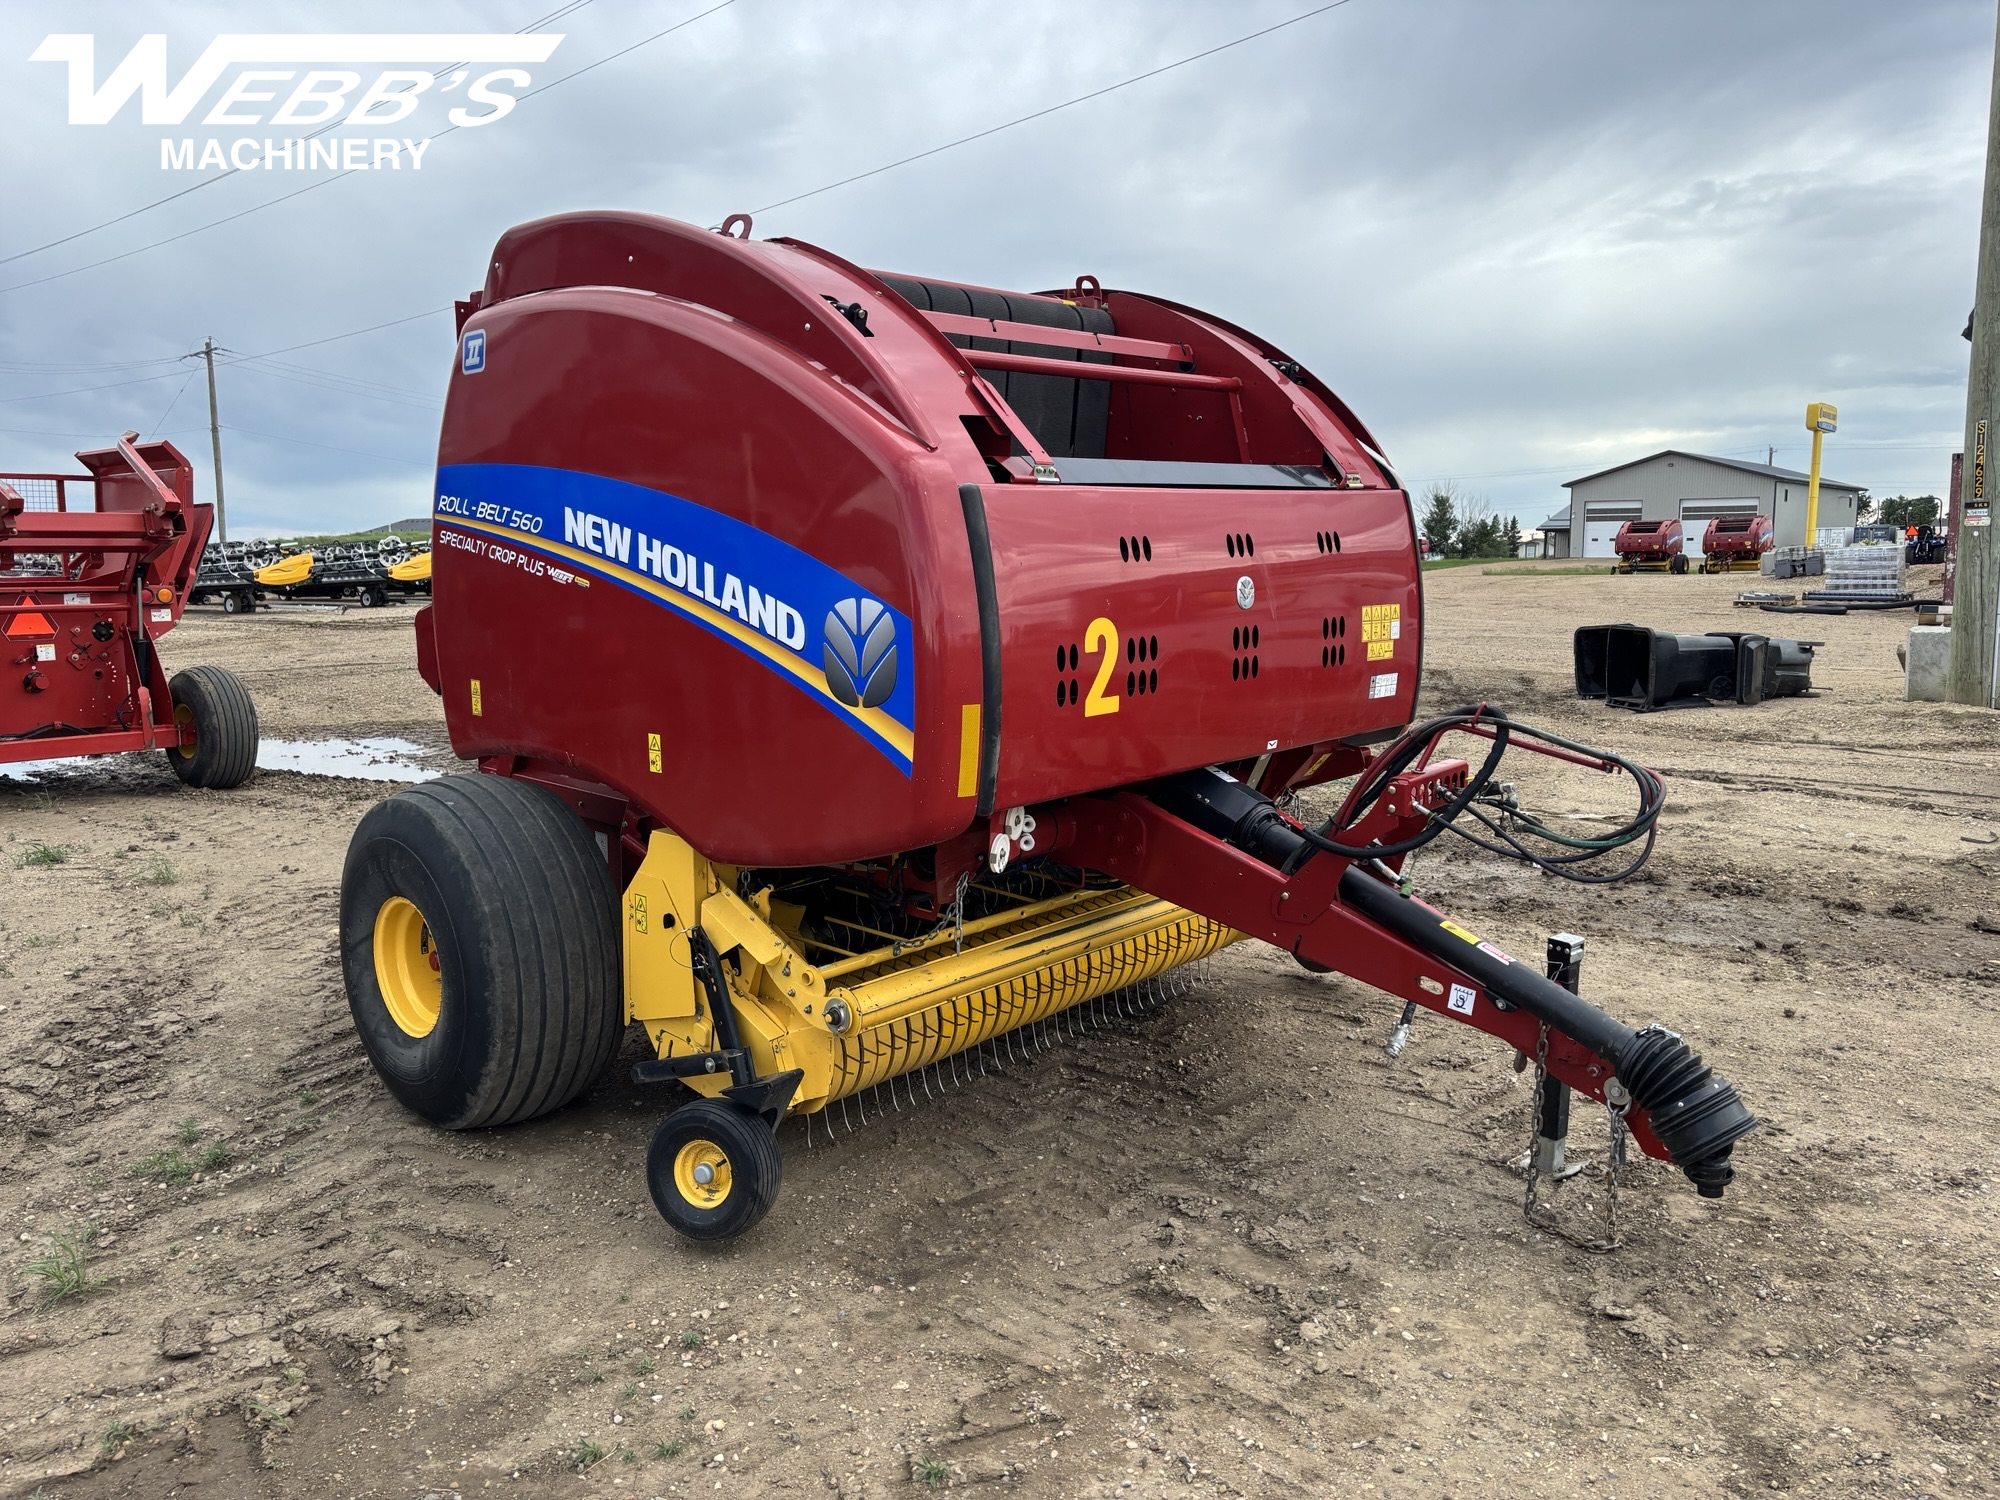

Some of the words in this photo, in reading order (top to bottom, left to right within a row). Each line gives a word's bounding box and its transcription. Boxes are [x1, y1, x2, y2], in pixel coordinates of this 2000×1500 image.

[1975, 423, 1986, 498] S124629
[439, 530, 488, 556] SPECIALTY
[489, 545, 516, 568] CROP
[517, 555, 545, 576] PLUS
[509, 510, 543, 533] 560
[564, 506, 632, 565] NEW
[638, 532, 806, 651] HOLLAND
[1084, 617, 1120, 717] 2
